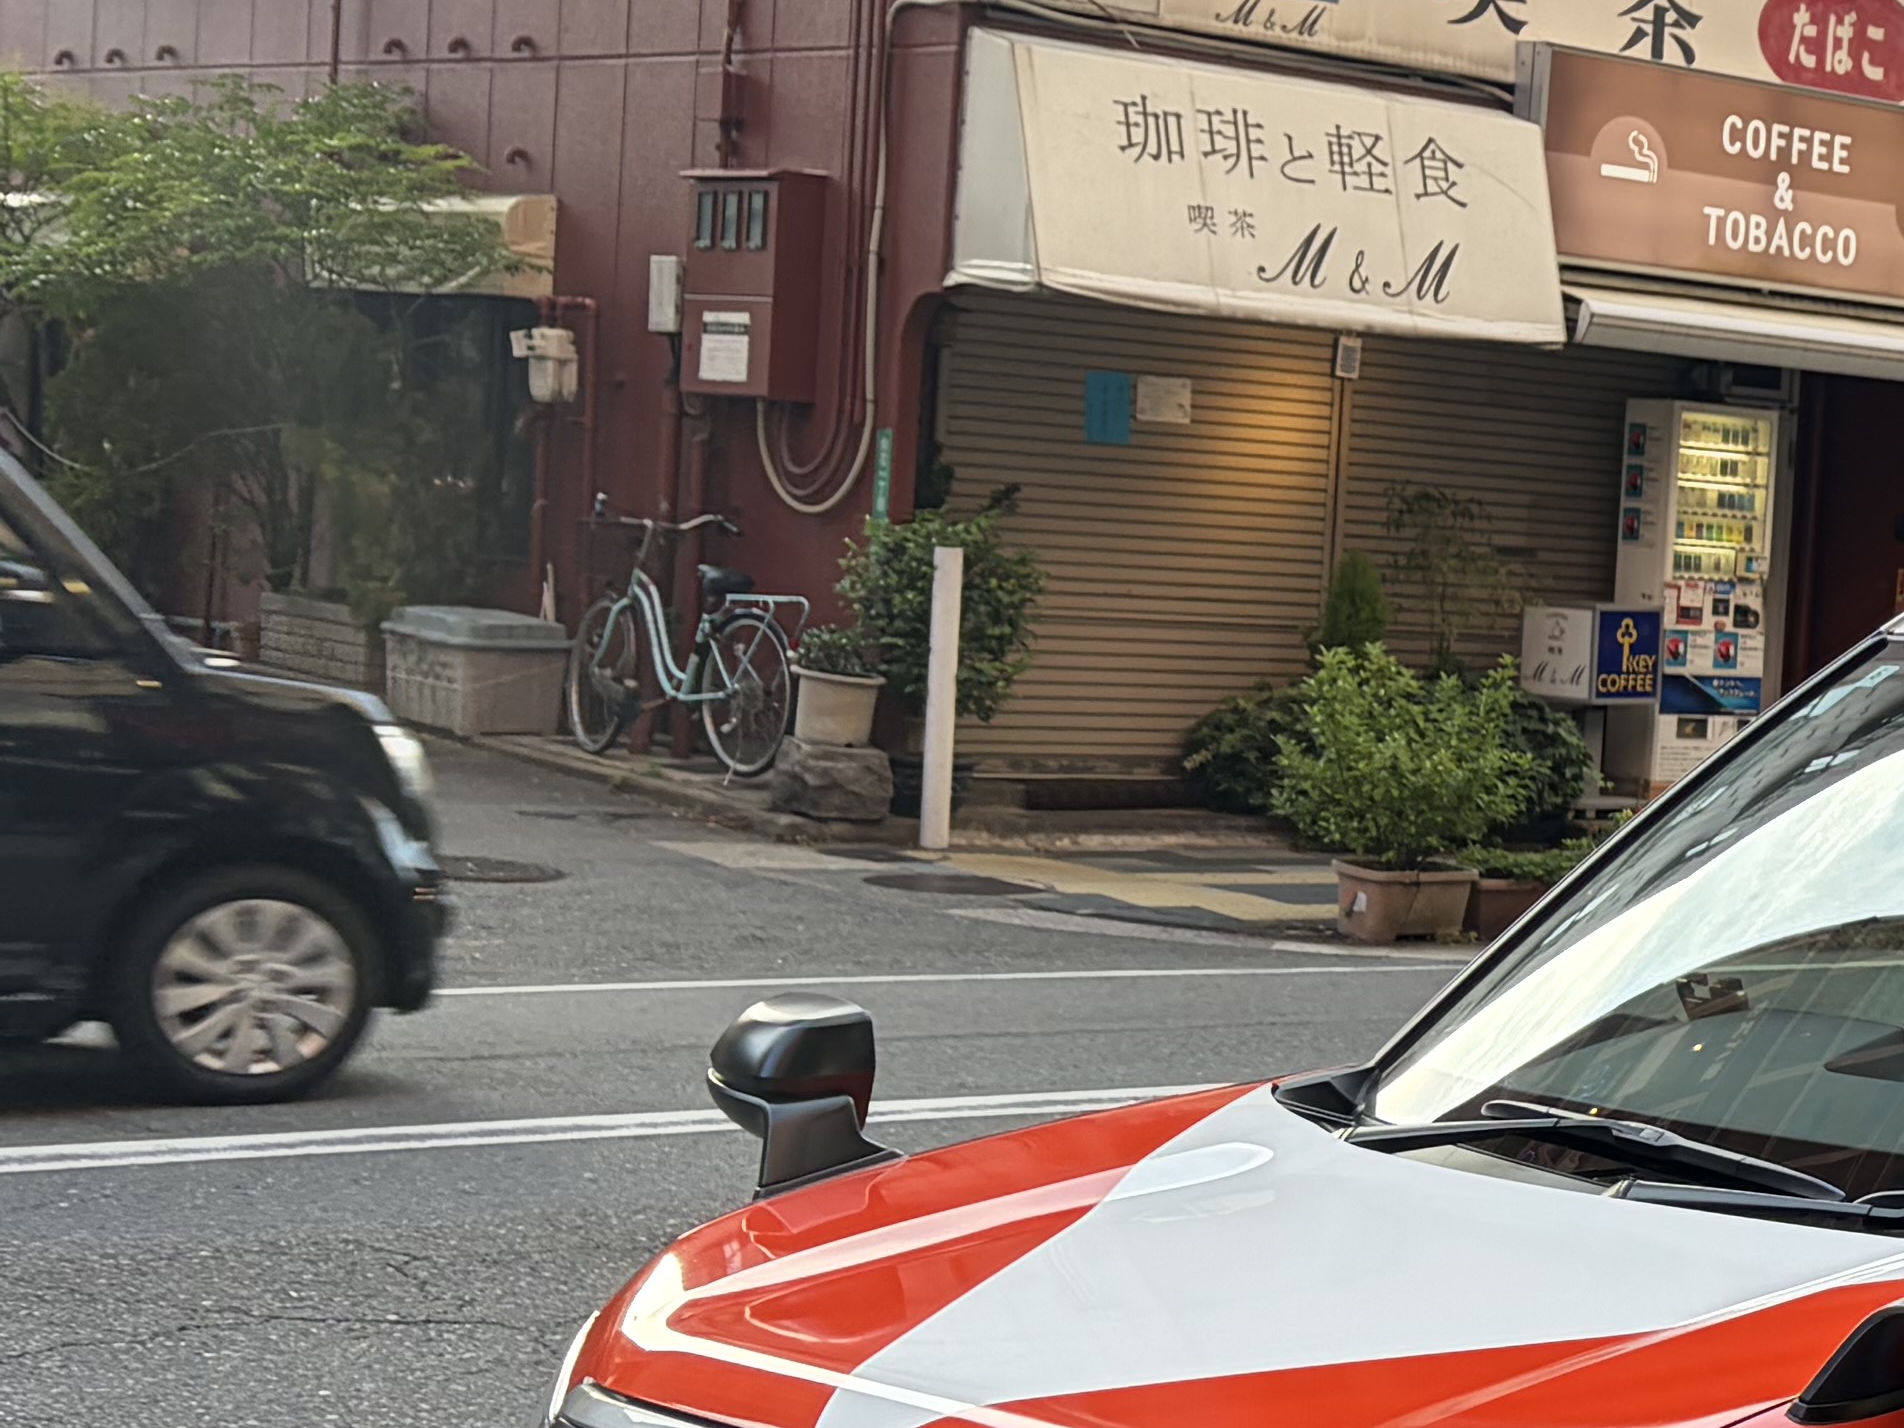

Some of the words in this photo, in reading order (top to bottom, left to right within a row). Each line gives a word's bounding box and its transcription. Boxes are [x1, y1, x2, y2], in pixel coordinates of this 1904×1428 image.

[1280, 3, 1328, 38] M
[1788, 2, 1886, 81] たばこ
[1112, 93, 1469, 209] 珈琲と軽食
[1721, 114, 1853, 175] COFFEE
[1772, 171, 1794, 212] &
[1186, 203, 1257, 241] 喫茶
[1702, 205, 1857, 267] TOBACCO
[1256, 222, 1339, 290] M
[1348, 249, 1372, 296] &
[1382, 239, 1461, 305] M
[1597, 673, 1655, 694] COFFEE
[1626, 654, 1657, 673] KEY
